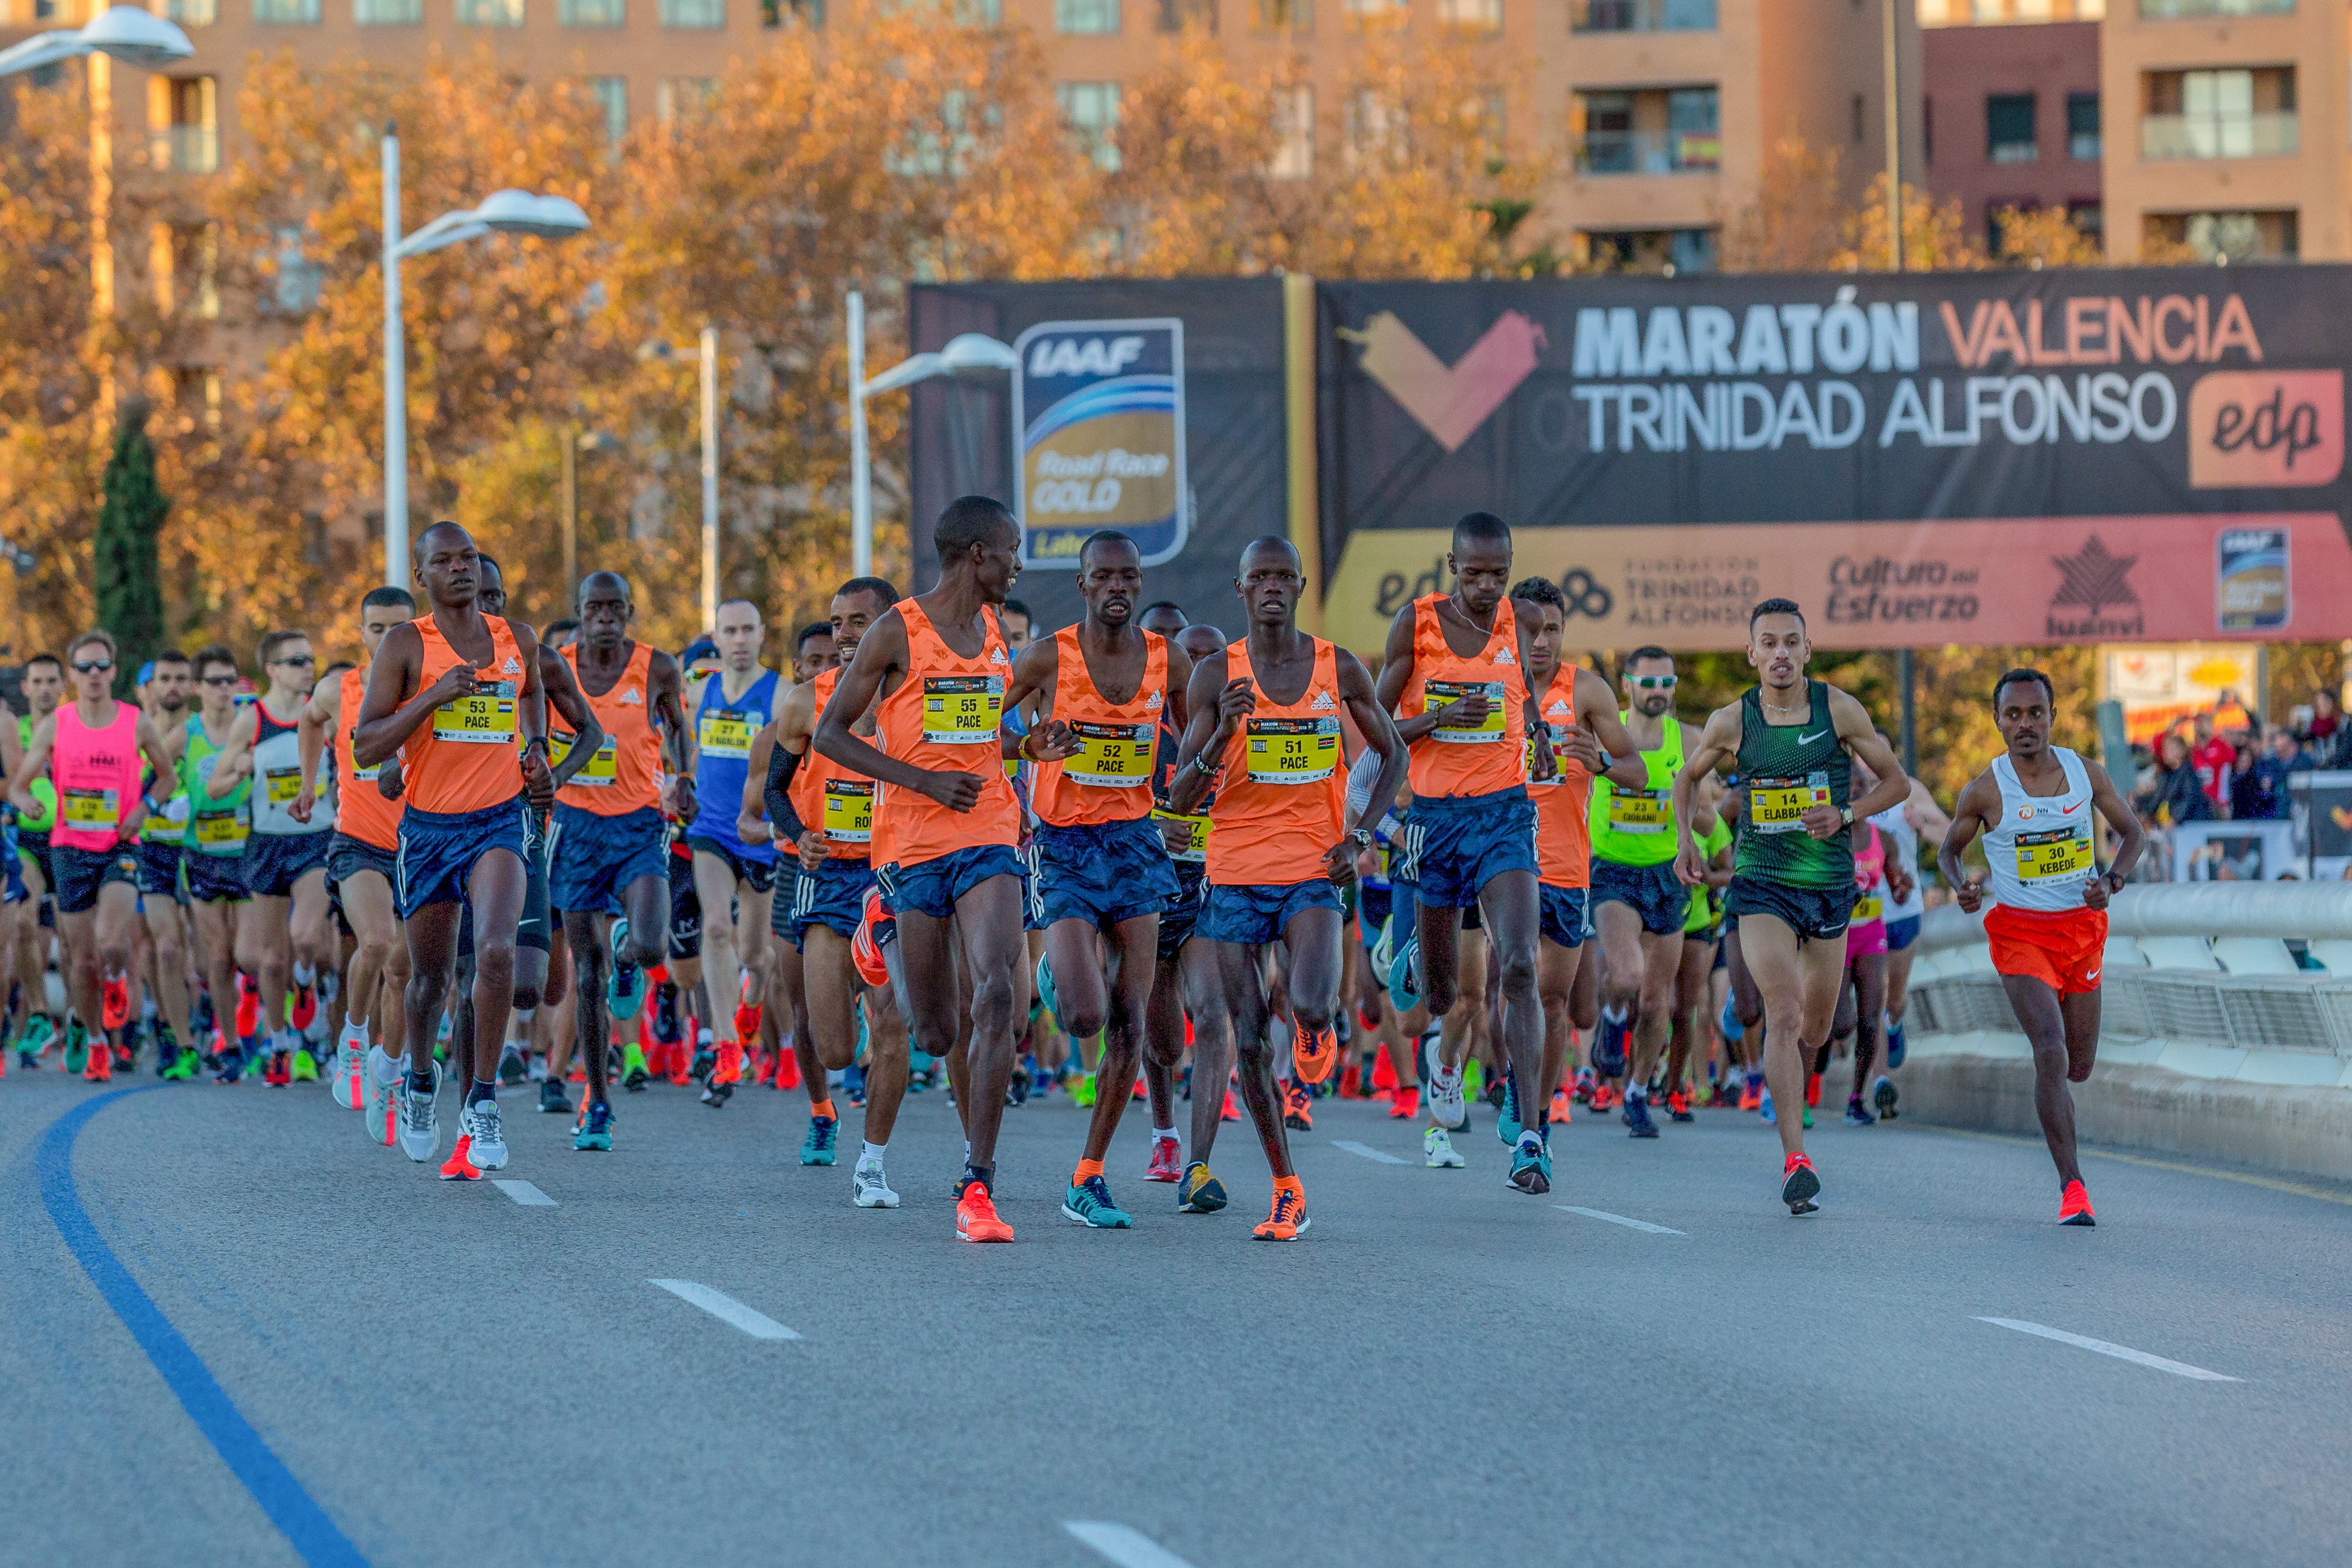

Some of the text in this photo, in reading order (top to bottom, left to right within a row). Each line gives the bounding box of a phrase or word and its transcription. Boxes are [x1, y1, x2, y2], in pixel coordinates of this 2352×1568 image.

[1575, 284, 2263, 378] MARATÓN VALENCIA
[1029, 336, 1146, 377] IAAF
[1572, 371, 2178, 452] TRINIDAD ALFONSO
[2212, 387, 2320, 470] edp
[1036, 451, 1106, 477] Road
[1032, 478, 1122, 513] GOLD
[1375, 553, 1457, 618] ed
[1626, 576, 1760, 599] TRINIDAD
[1825, 590, 1980, 624] Esfuerzo
[470, 701, 486, 714] 53
[960, 698, 977, 712] 55
[465, 716, 490, 728] PACE
[956, 715, 981, 728] PACE
[1103, 745, 1121, 757] 52
[1285, 740, 1302, 754] 51
[1096, 760, 1124, 772] PACE
[1280, 756, 1308, 769] PACE
[1782, 793, 1798, 805] 14
[1764, 806, 1813, 820] ELABBA
[2048, 846, 2065, 859] 30
[2039, 857, 2076, 874] KEBEDE
